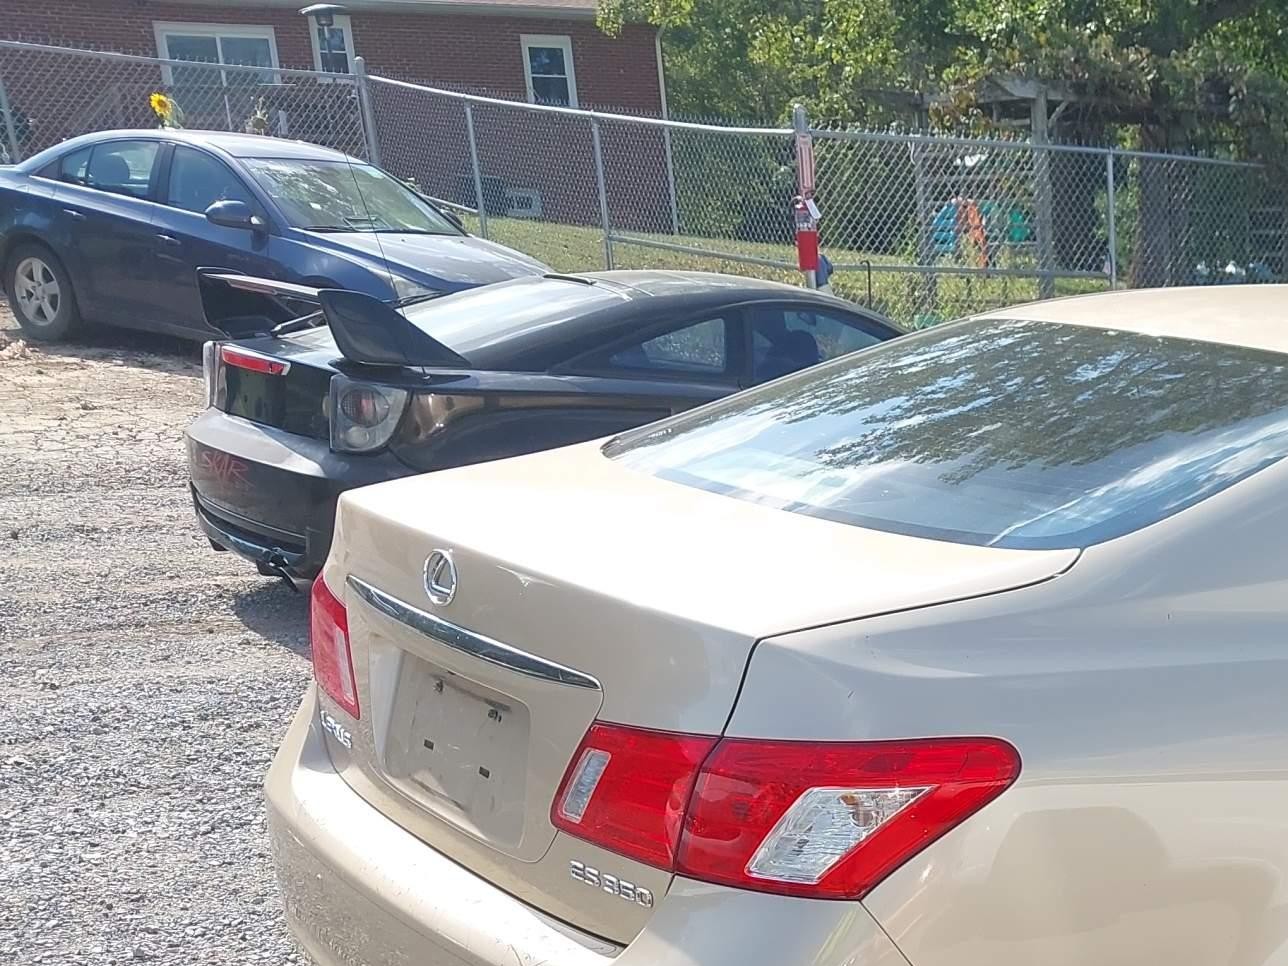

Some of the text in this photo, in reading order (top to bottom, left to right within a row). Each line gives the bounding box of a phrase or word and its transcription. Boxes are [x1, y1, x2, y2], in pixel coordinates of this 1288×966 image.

[319, 709, 352, 749] LEXUS
[568, 858, 654, 909] ES 350
